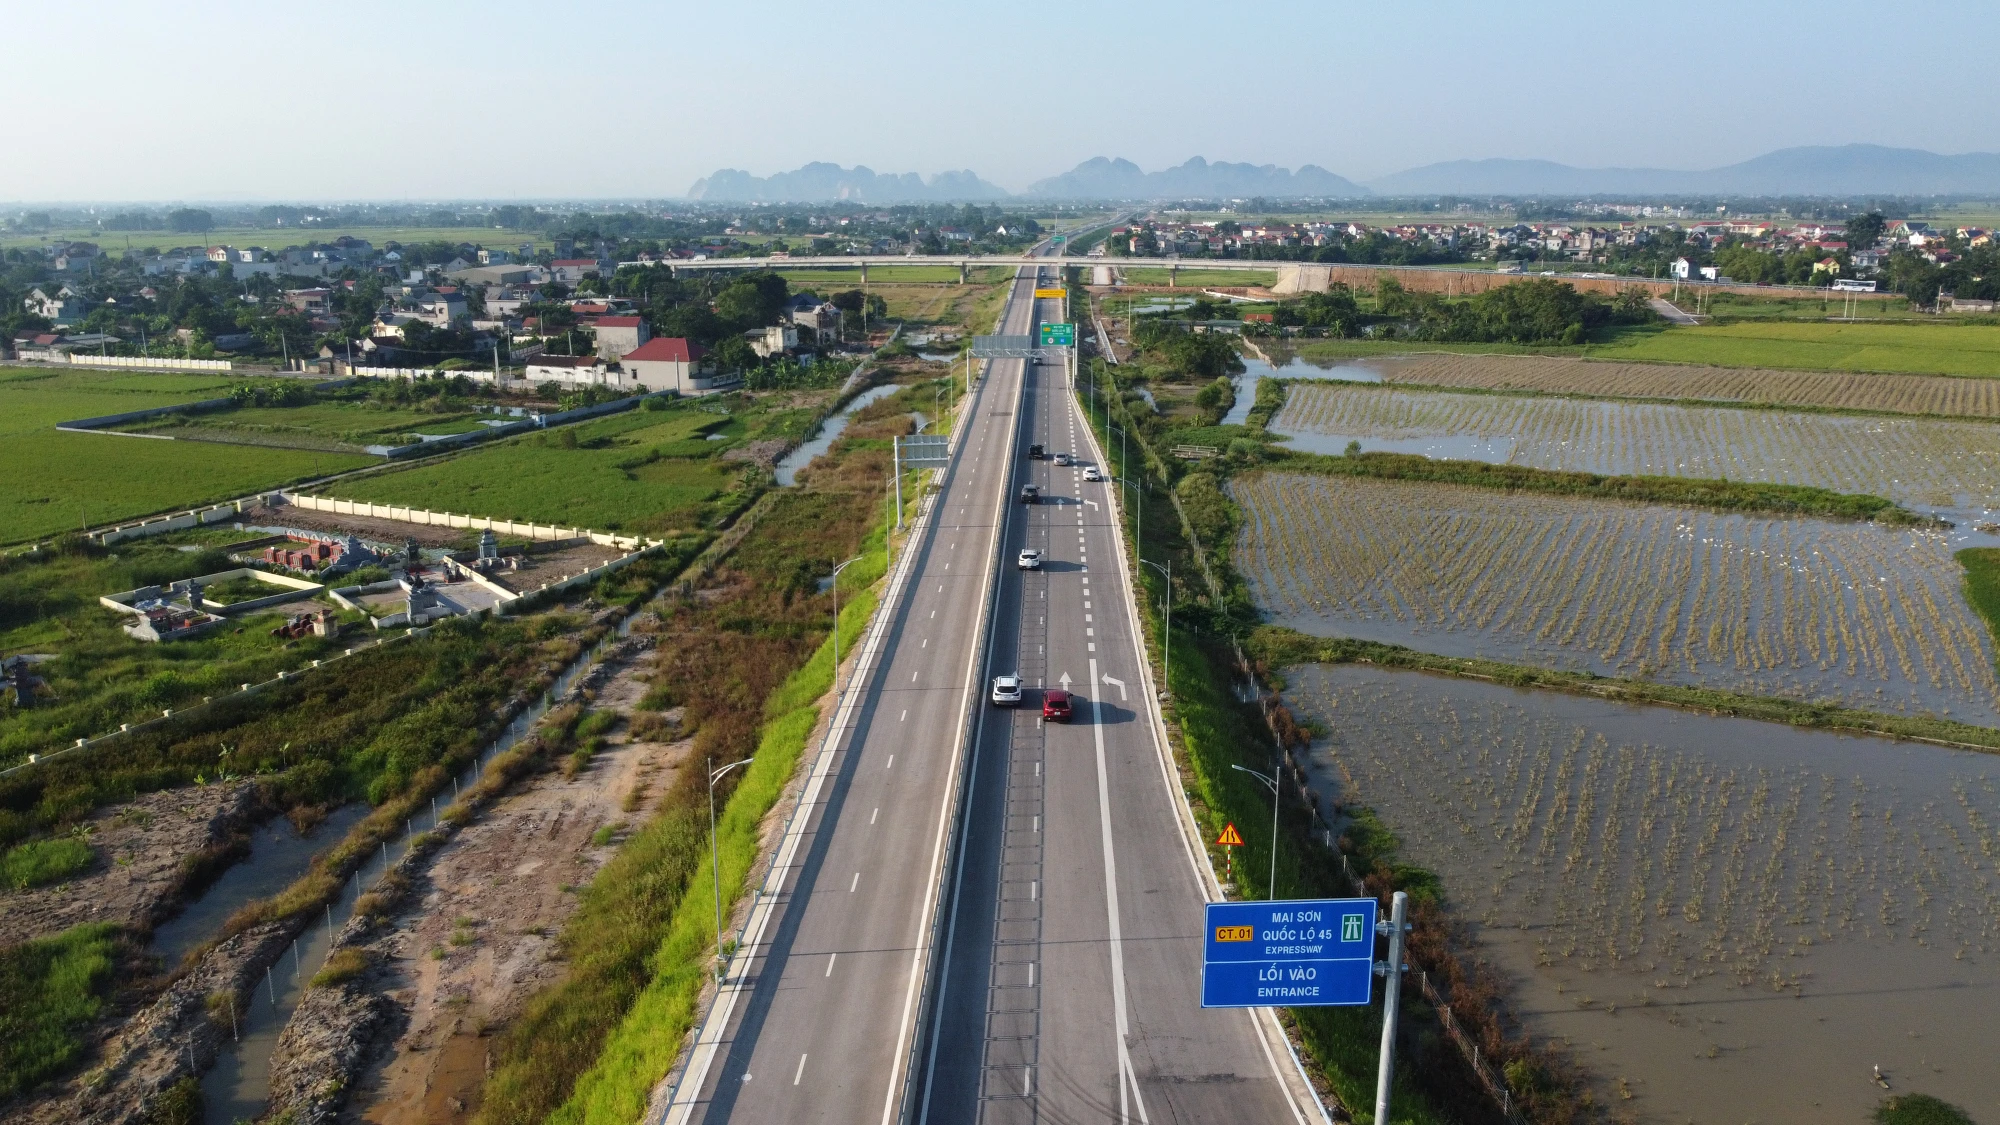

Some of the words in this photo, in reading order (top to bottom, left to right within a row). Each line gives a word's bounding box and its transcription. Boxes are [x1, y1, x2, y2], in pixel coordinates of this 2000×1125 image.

[1272, 913, 1293, 923] MAI
[1297, 910, 1321, 922] SƠN
[1218, 928, 1251, 939] CT.01
[1262, 925, 1296, 941] QUỐC
[1300, 928, 1315, 942] LỘ
[1318, 929, 1332, 940] 45
[1265, 945, 1323, 954] EXPRESSWAY
[1259, 962, 1282, 981] LỐI
[1289, 965, 1316, 980] VÀO
[1258, 986, 1320, 997] ENTRANCE
